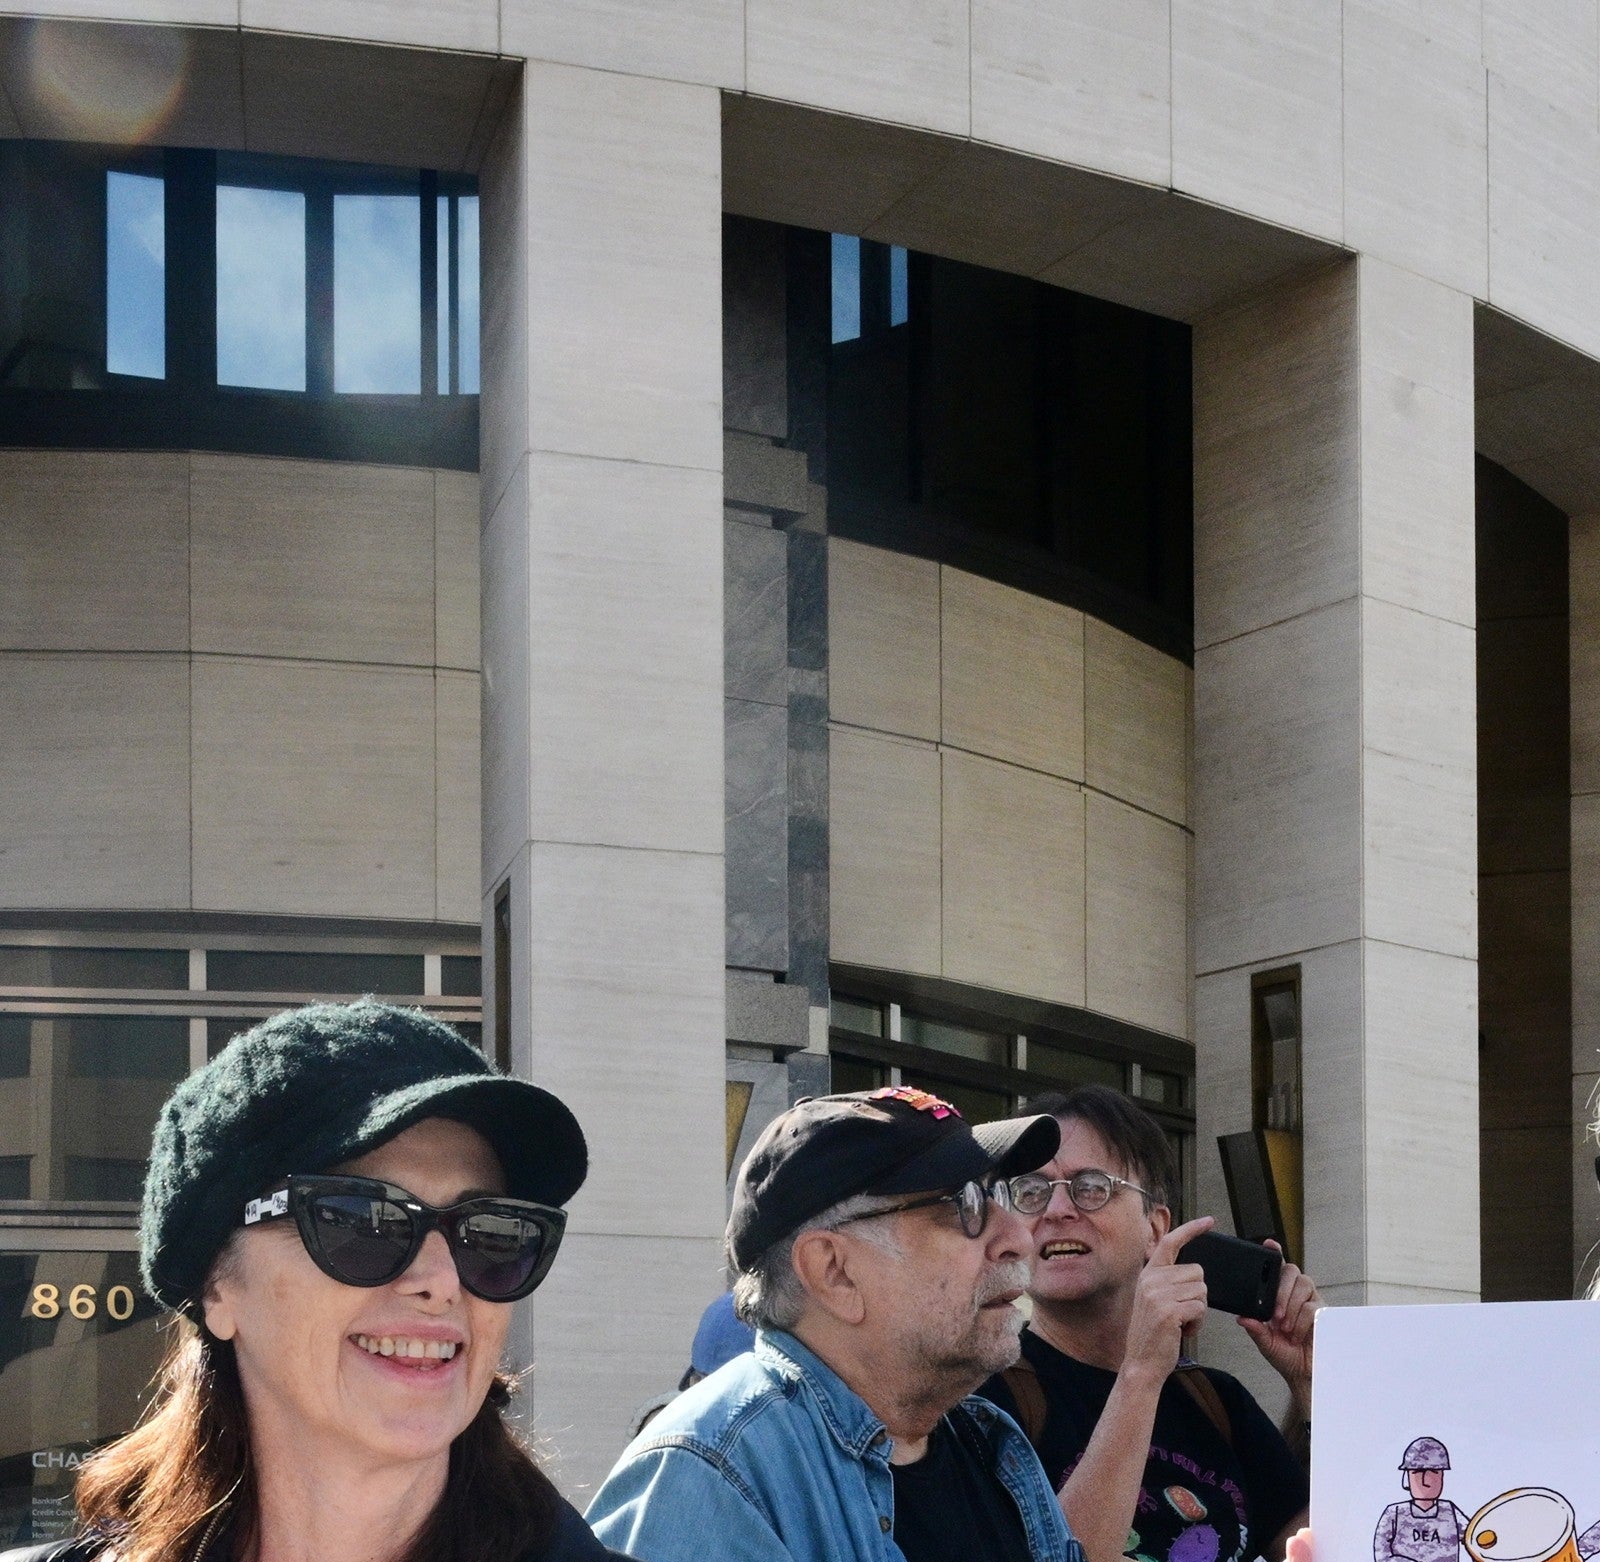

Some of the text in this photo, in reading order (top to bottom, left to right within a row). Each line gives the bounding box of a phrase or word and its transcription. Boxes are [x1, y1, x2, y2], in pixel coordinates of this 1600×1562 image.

[31, 1283, 135, 1321] 860
[32, 1452, 93, 1468] CHA
[1412, 1528, 1441, 1544] DEA
